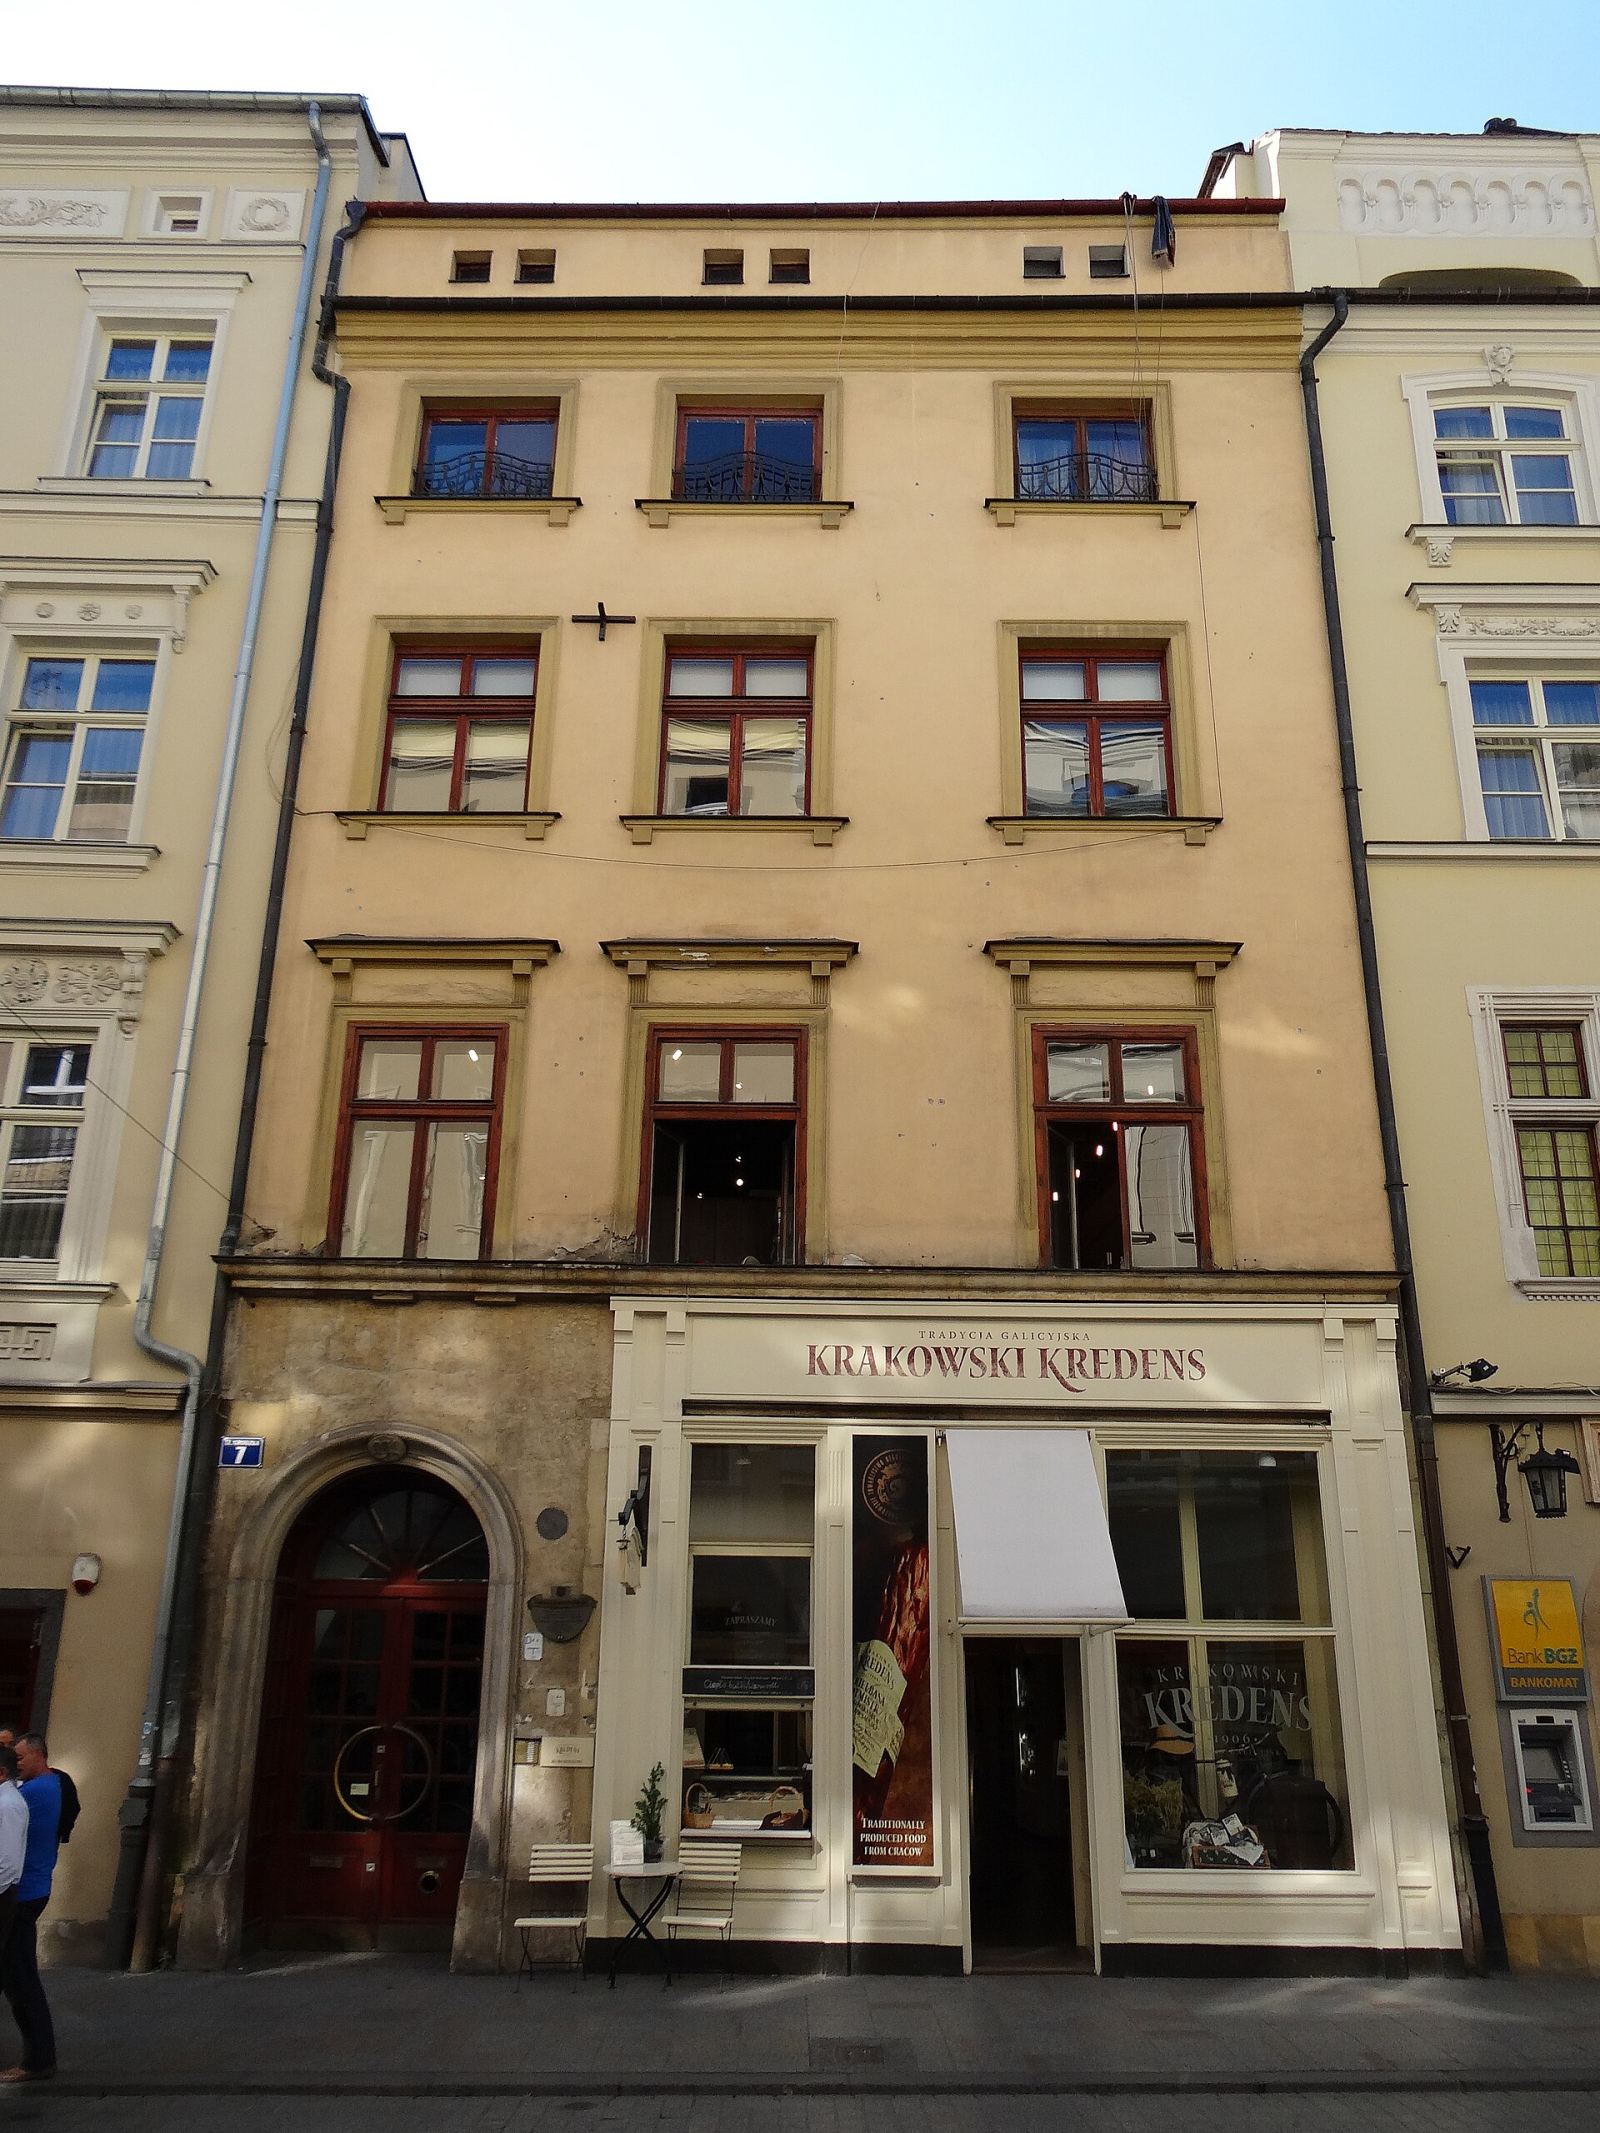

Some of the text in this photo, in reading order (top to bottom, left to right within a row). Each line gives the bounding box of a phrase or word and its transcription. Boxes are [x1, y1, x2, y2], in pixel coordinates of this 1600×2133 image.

[918, 1330, 1091, 1342] TRADYCJA GALICYJSKA
[806, 1344, 1207, 1393] KRAKOWSKI KREDENS
[234, 1446, 248, 1464] 7
[1507, 1647, 1543, 1664] Bank
[1510, 1676, 1578, 1689] BANKOMAT
[1143, 1685, 1314, 1739] KREDENS
[862, 1817, 925, 1830] TRADITIONALLY
[859, 1832, 927, 1844] PRODUCED FOOD
[863, 1846, 923, 1857] FROM CRACOW
